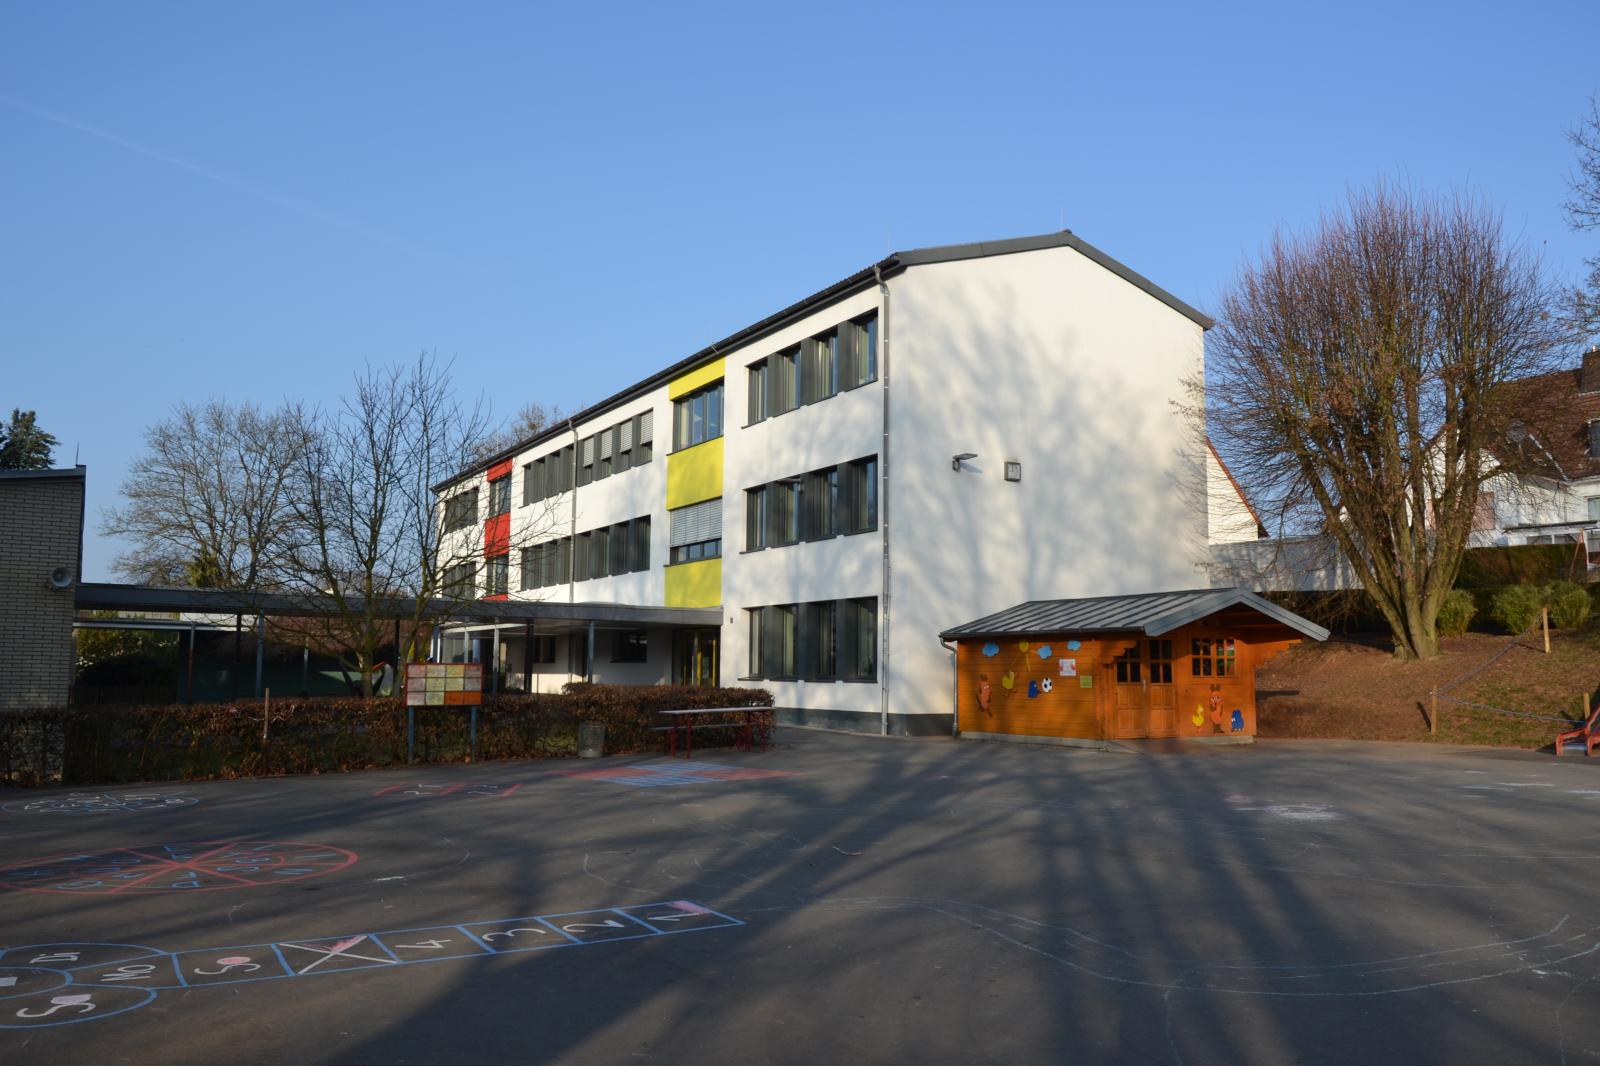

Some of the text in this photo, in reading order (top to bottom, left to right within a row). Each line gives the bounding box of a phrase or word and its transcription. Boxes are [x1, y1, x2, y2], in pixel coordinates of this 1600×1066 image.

[562, 919, 626, 934] 2
[481, 927, 548, 943] 3
[394, 937, 452, 950] 4
